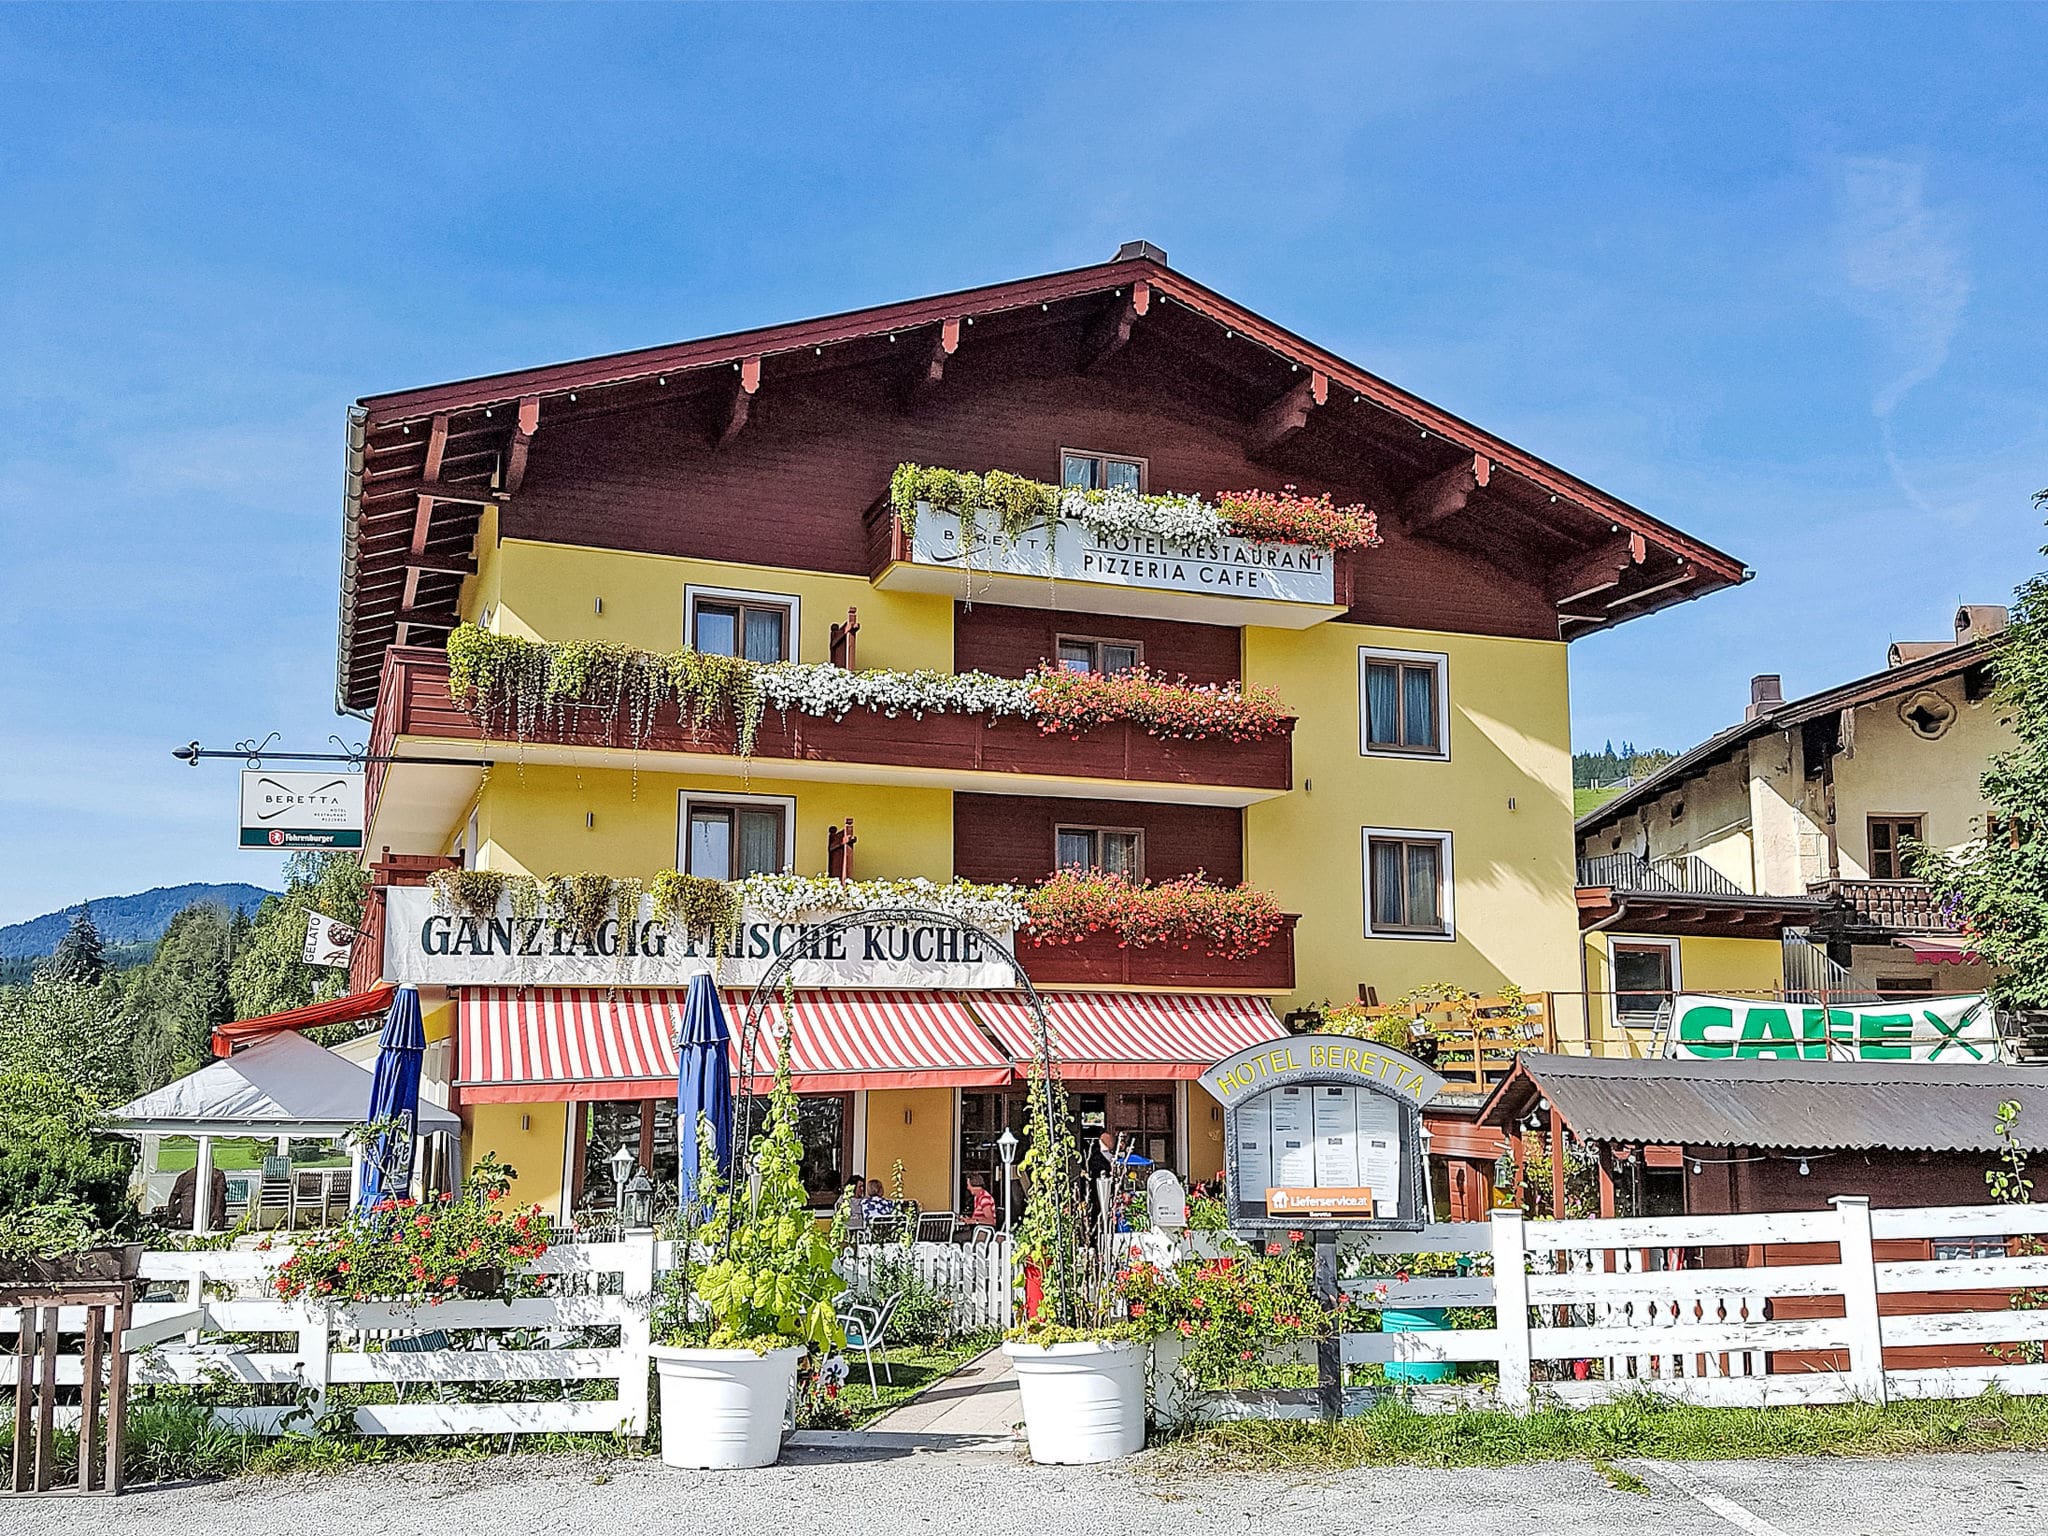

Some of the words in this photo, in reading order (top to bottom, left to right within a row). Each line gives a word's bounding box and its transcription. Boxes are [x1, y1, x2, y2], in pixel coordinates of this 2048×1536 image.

[1083, 554, 1186, 581] PIZZERIA
[1097, 535, 1167, 555] HOTEL
[1181, 542, 1323, 571] RESTAURANT
[265, 795, 339, 804] BERETTA
[304, 917, 321, 962] GELATO
[1680, 1005, 1913, 1061] CAFE
[1216, 1048, 1302, 1096] HOTEL
[1310, 1045, 1425, 1098] BERETTA
[1290, 1196, 1368, 1207] Lieferservice.at
